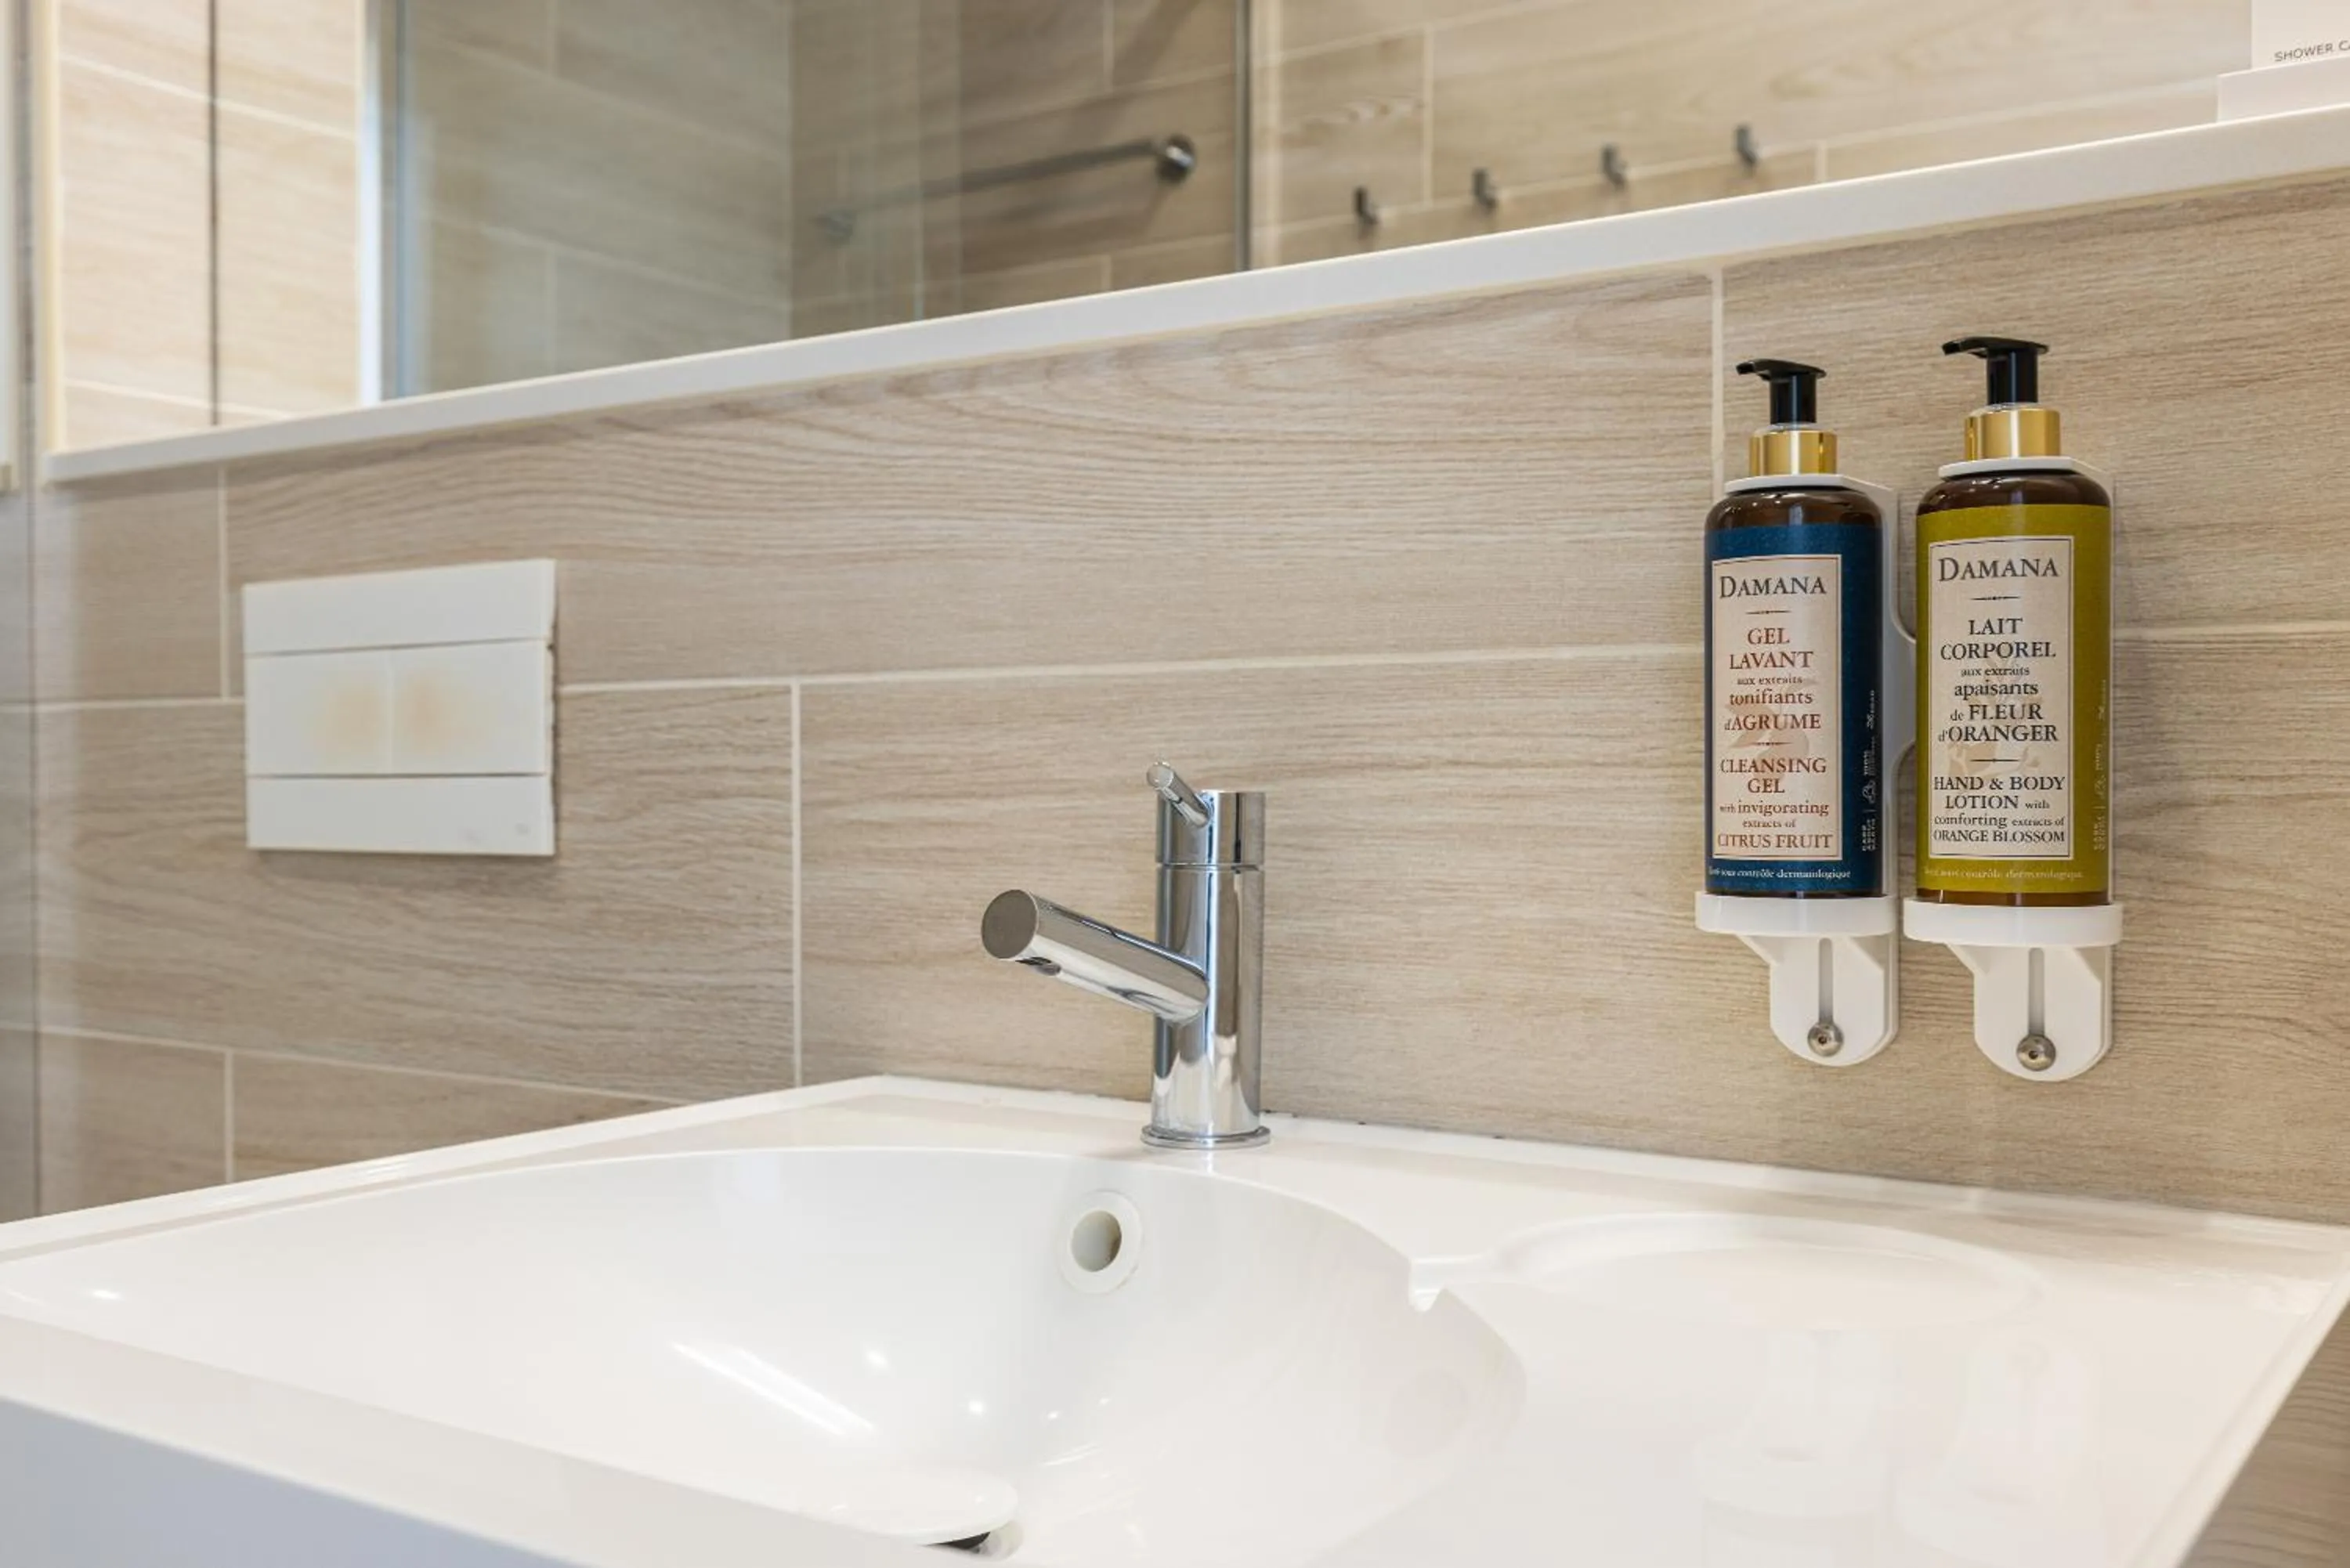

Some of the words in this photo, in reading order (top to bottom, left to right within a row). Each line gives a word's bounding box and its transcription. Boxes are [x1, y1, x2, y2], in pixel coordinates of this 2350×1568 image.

[2274, 42, 2334, 62] SHOWER
[2338, 40, 2350, 52] C
[1939, 557, 2059, 582] DAMANA
[1719, 576, 1828, 599] DAMANA
[1968, 617, 2023, 635] LAIT
[1747, 627, 1790, 645] GEL
[1940, 641, 2057, 660] CORPOREL
[1730, 651, 1814, 670] LAVANT
[1984, 665, 2030, 676] extraits
[1759, 674, 1803, 685] extraits
[1729, 688, 1813, 706] tonifiants
[1954, 678, 2039, 700] apaisants
[1950, 709, 1965, 721] de
[1969, 703, 2043, 721] FLEUR
[1938, 724, 2059, 742] d'ORANGER
[1721, 757, 1827, 774] CLEANSING
[1748, 777, 1785, 794] GEL
[1934, 776, 1983, 790] HAND
[1989, 777, 2003, 790] &
[2010, 776, 2066, 790] BODY
[1737, 800, 1830, 817] invigorating
[1945, 795, 2019, 809] LOTION
[2025, 800, 2050, 810] with
[1743, 818, 1782, 829] extracts
[1784, 819, 1797, 829] of
[1935, 812, 2008, 829] comforting
[2012, 816, 2052, 826] extracts
[2055, 815, 2066, 826] of
[1717, 834, 1771, 847] CITRUS
[1776, 834, 1833, 848] FRUIT
[1932, 830, 1989, 843] ORANGE
[1993, 830, 2065, 843] BLOSSOM
